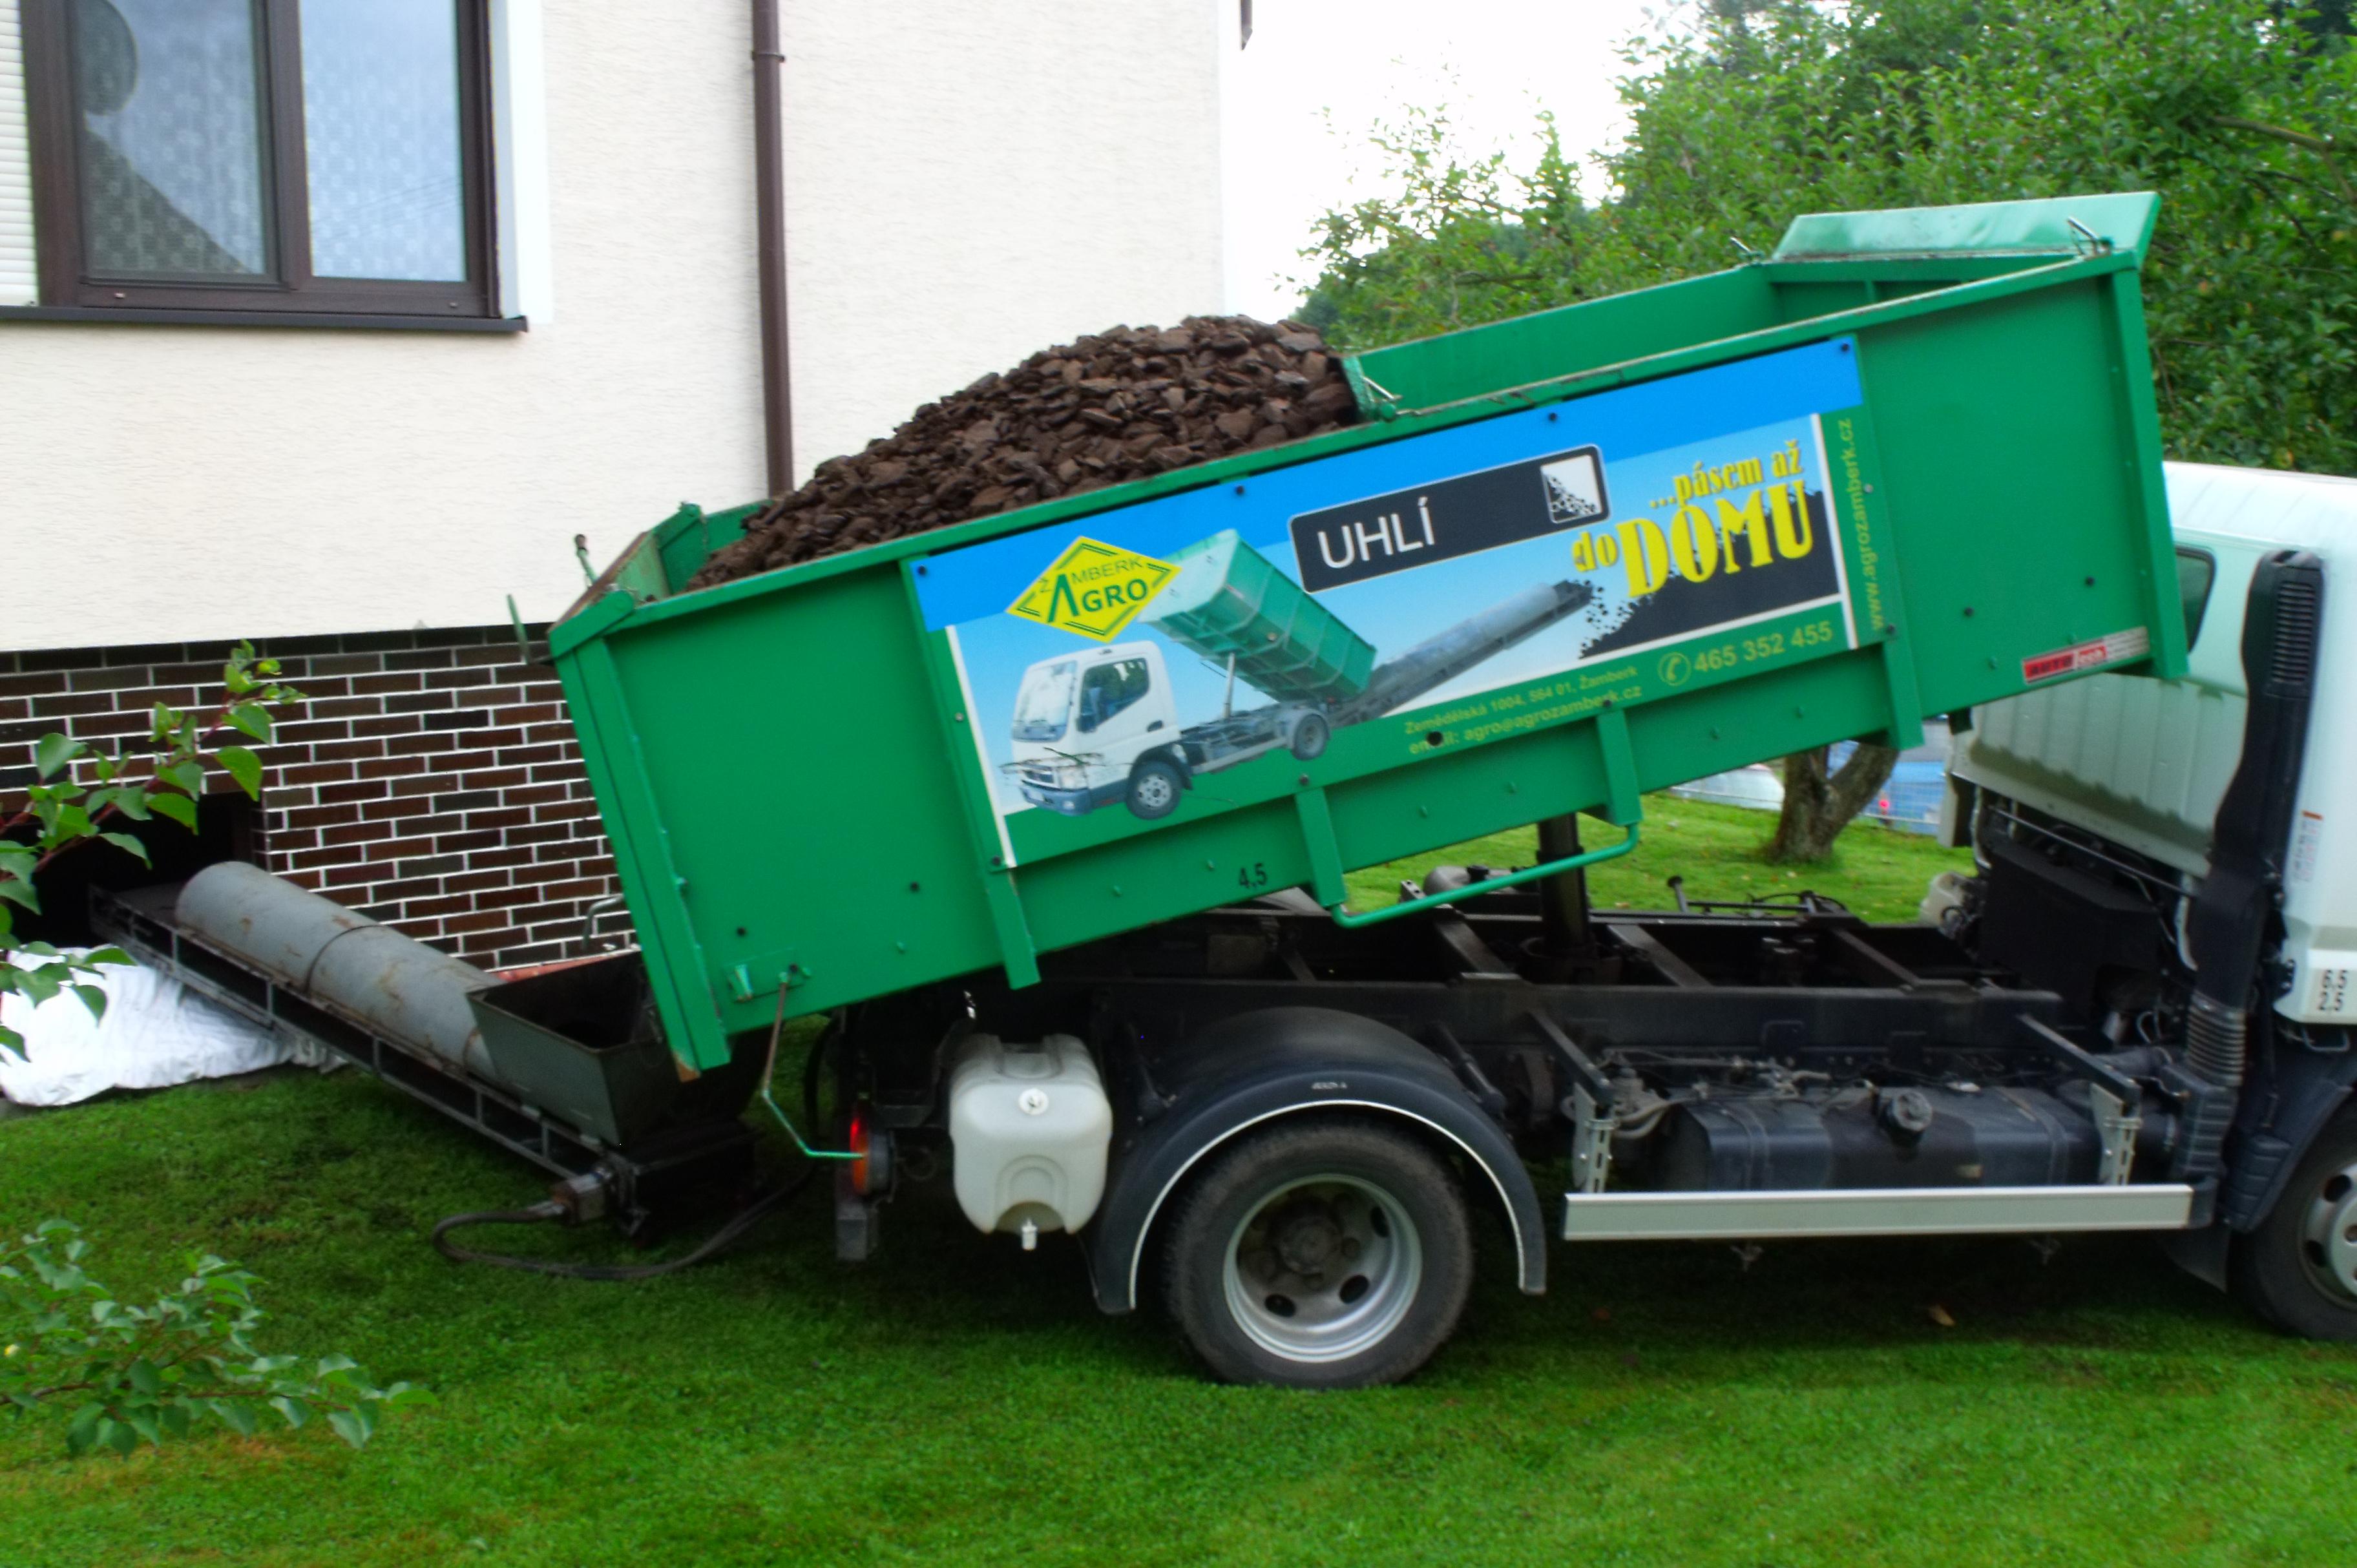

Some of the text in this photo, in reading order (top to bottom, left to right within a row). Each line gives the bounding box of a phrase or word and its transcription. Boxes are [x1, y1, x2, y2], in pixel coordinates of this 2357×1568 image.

[1771, 439, 1803, 478] až
[1317, 496, 1435, 569] UHLÍ
[1838, 418, 1884, 631] www.agrozamberk.cz
[1572, 531, 1618, 573] do
[1694, 620, 1833, 672] 465 352 455
